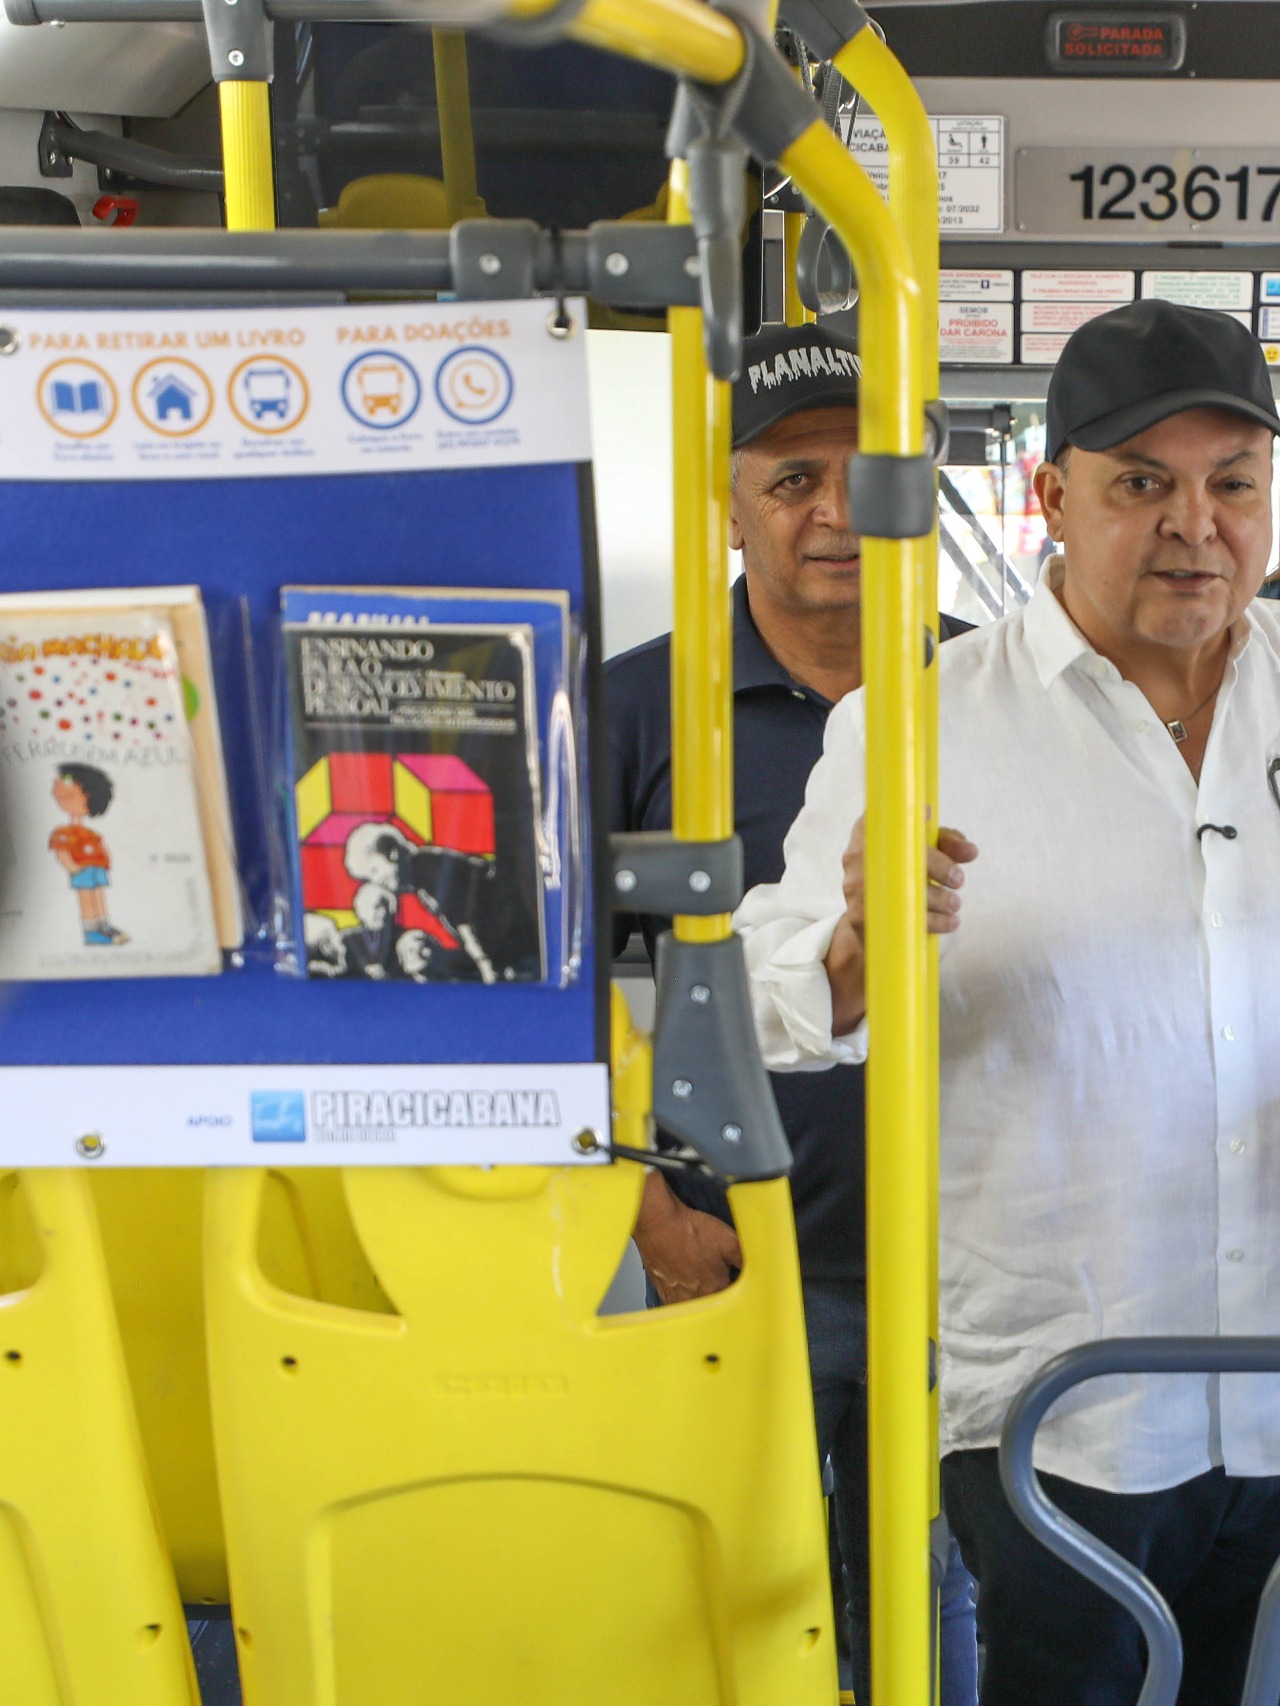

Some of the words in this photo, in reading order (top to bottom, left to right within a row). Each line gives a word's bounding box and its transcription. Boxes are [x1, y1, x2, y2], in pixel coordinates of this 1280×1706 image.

[1101, 27, 1165, 40] PARADA
[1063, 43, 1163, 56] SOLICITADA
[336, 324, 398, 344] PARA
[403, 314, 512, 344] DOAÇÕES
[948, 318, 999, 329] PROIBIDO
[28, 331, 91, 350] PARA
[96, 331, 189, 350] RETIRAR
[193, 329, 231, 348] UM
[236, 327, 306, 348] LIVRO
[939, 328, 962, 338] DAR
[964, 328, 1008, 338] CARONA
[309, 1088, 562, 1129] PIRACICABANA
